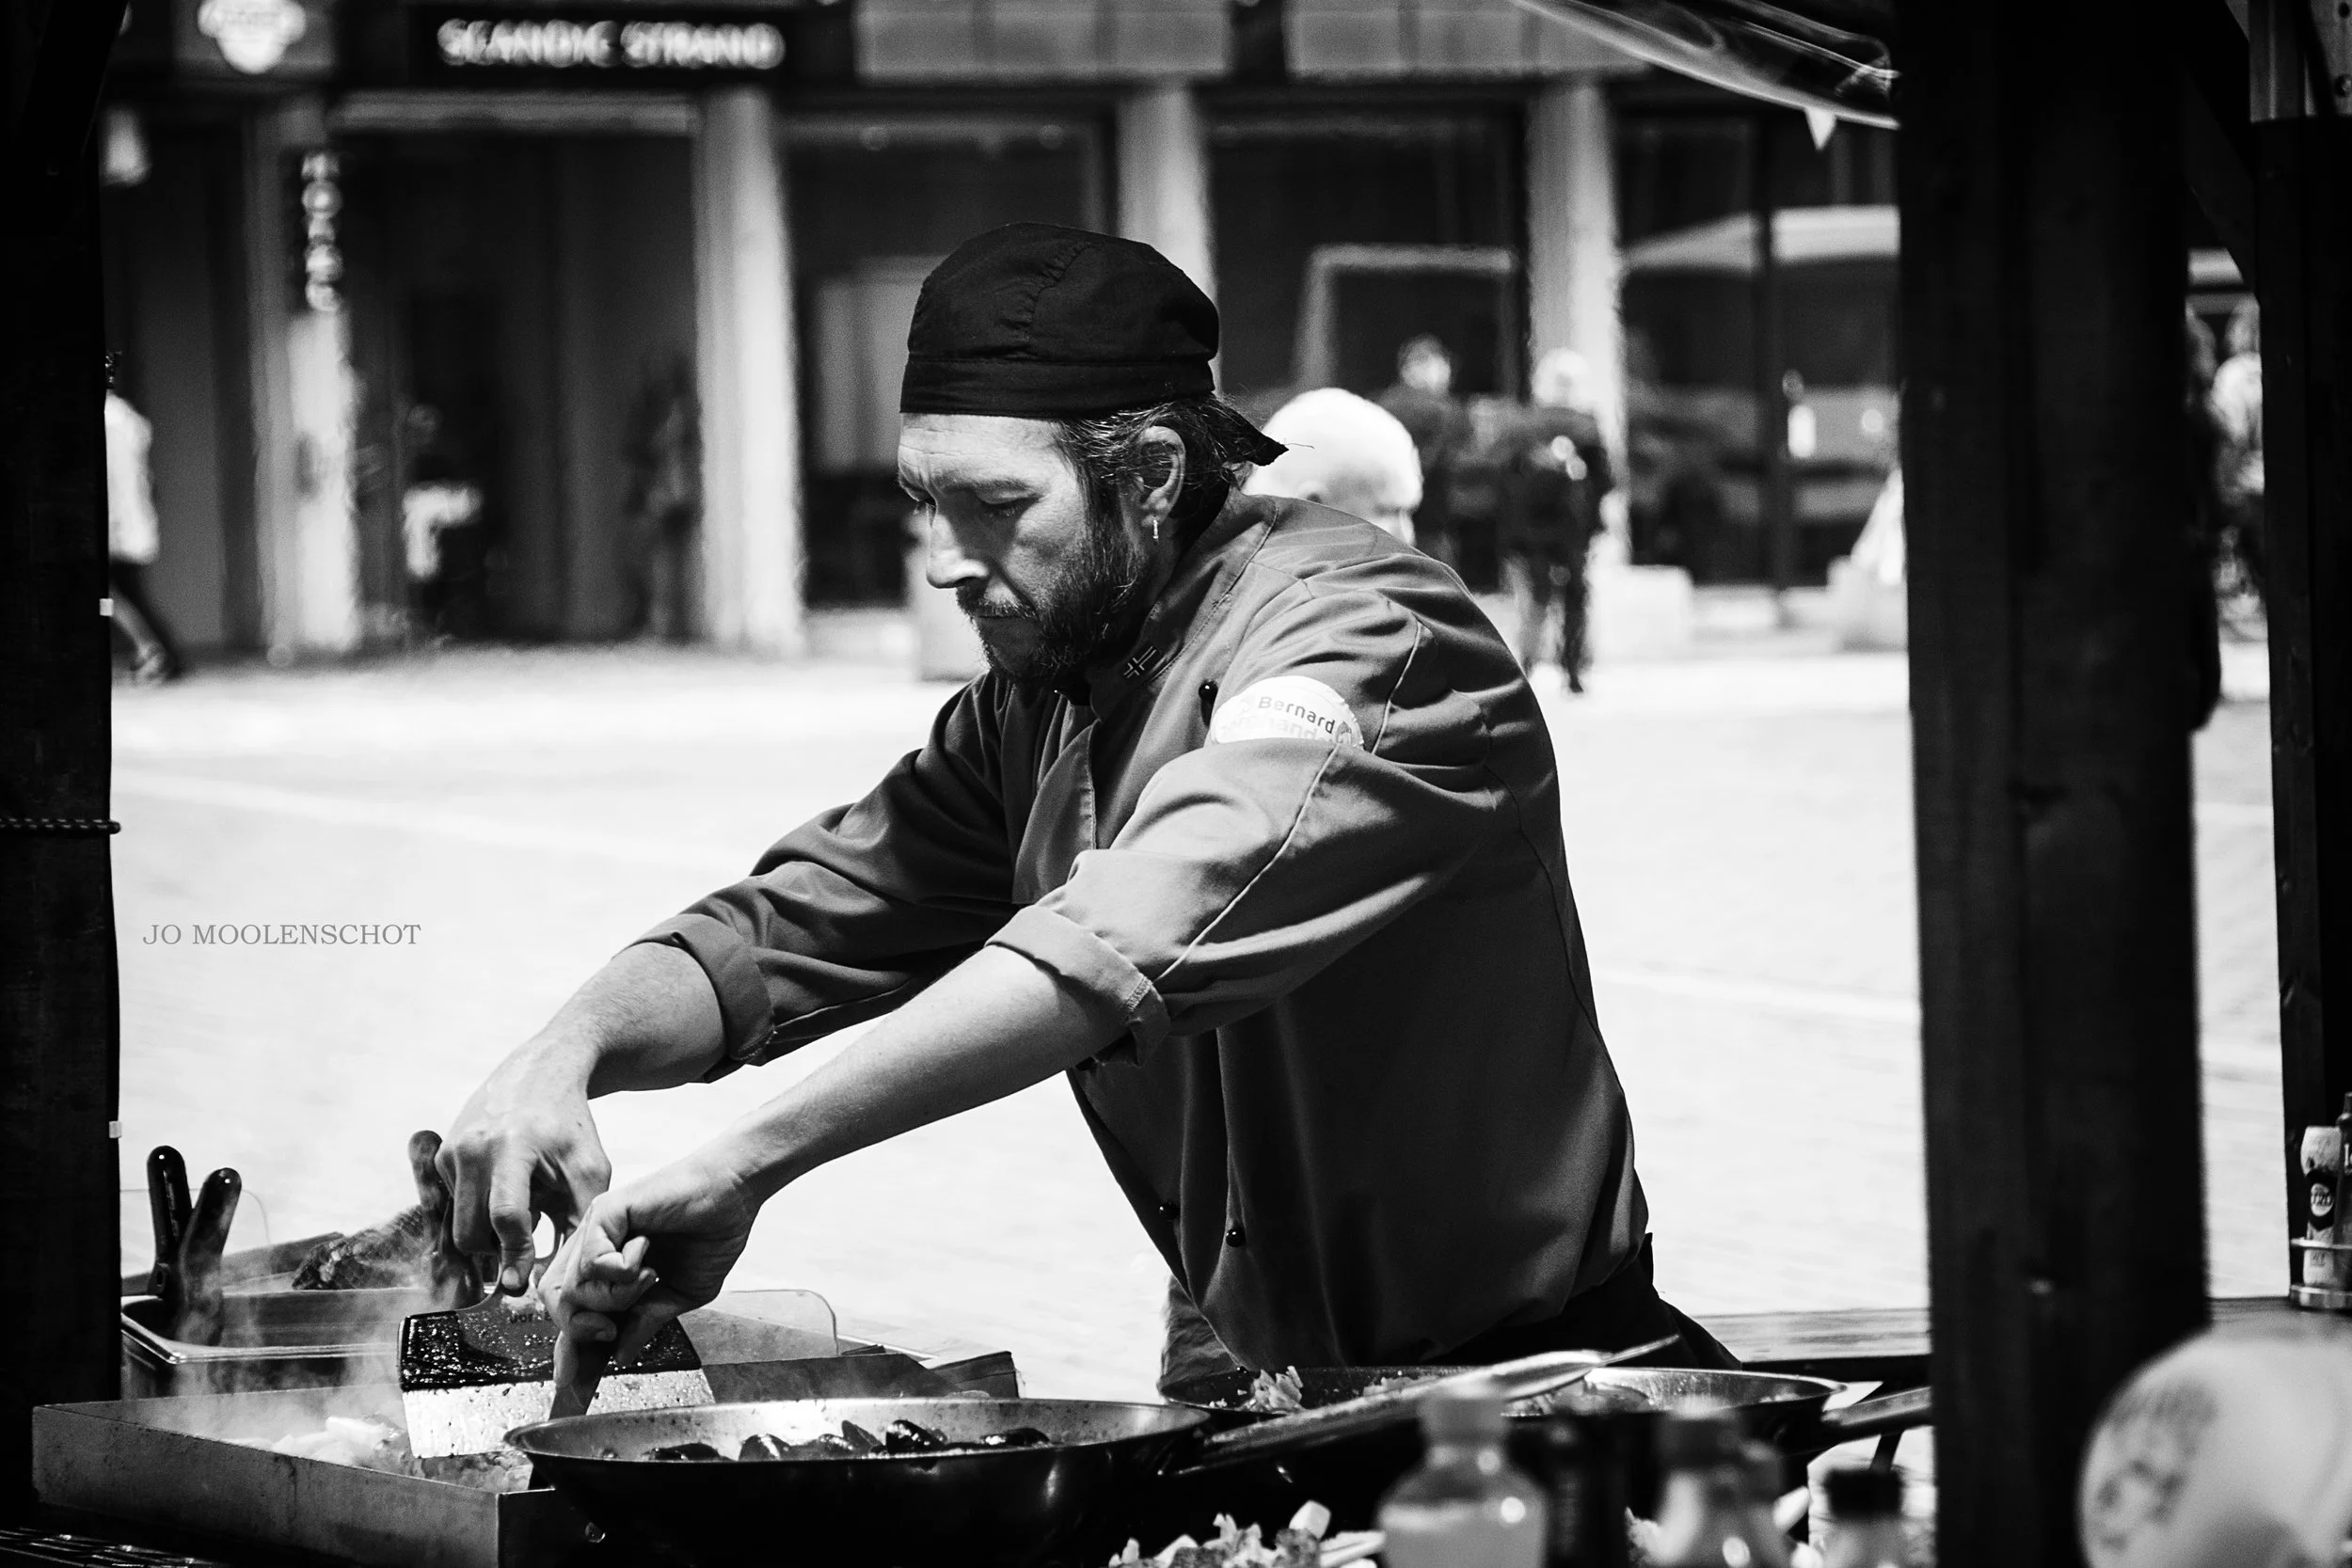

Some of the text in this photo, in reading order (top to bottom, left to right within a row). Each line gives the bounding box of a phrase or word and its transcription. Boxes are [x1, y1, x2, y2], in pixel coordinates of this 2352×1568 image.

[437, 19, 786, 69] SCANDIC STRAND
[1257, 695, 1337, 735] Bernard
